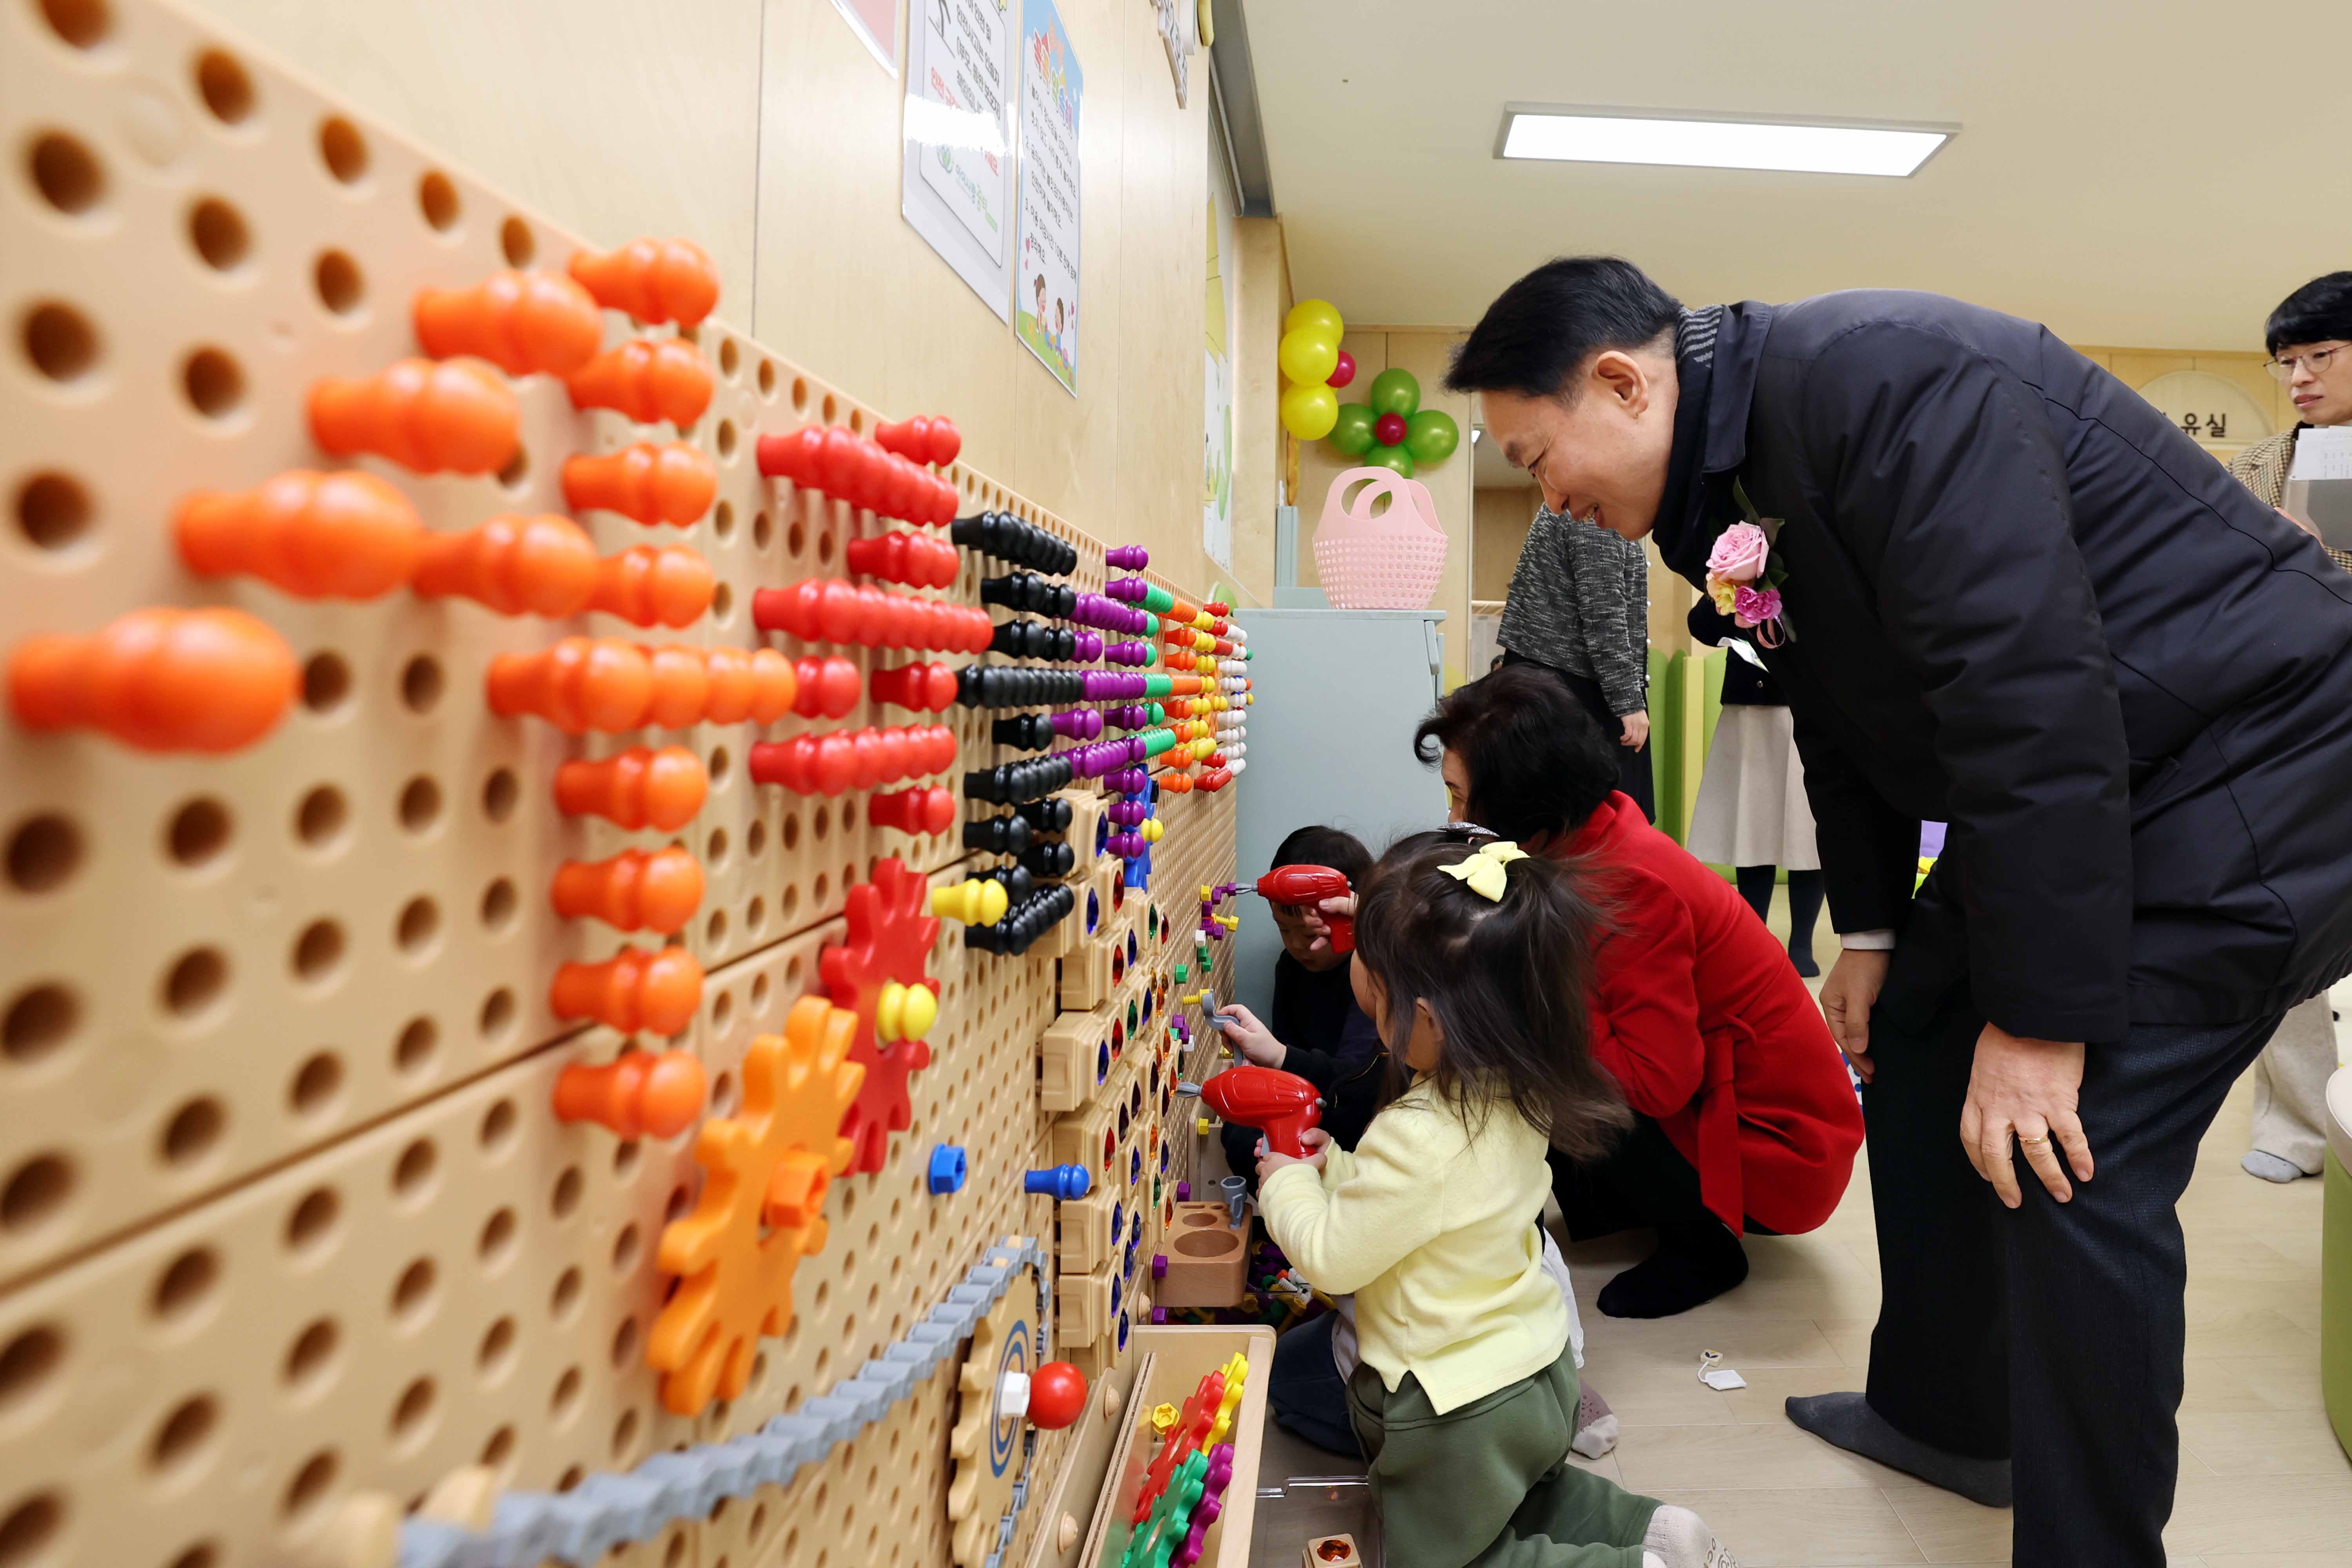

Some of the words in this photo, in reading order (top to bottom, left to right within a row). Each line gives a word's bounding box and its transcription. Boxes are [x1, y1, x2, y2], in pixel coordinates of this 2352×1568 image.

[957, 4, 984, 63] 안전사고는
[1031, 171, 1046, 206] 안전하게
[1031, 205, 1038, 227] 이용
[2161, 411, 2227, 438] 유실
